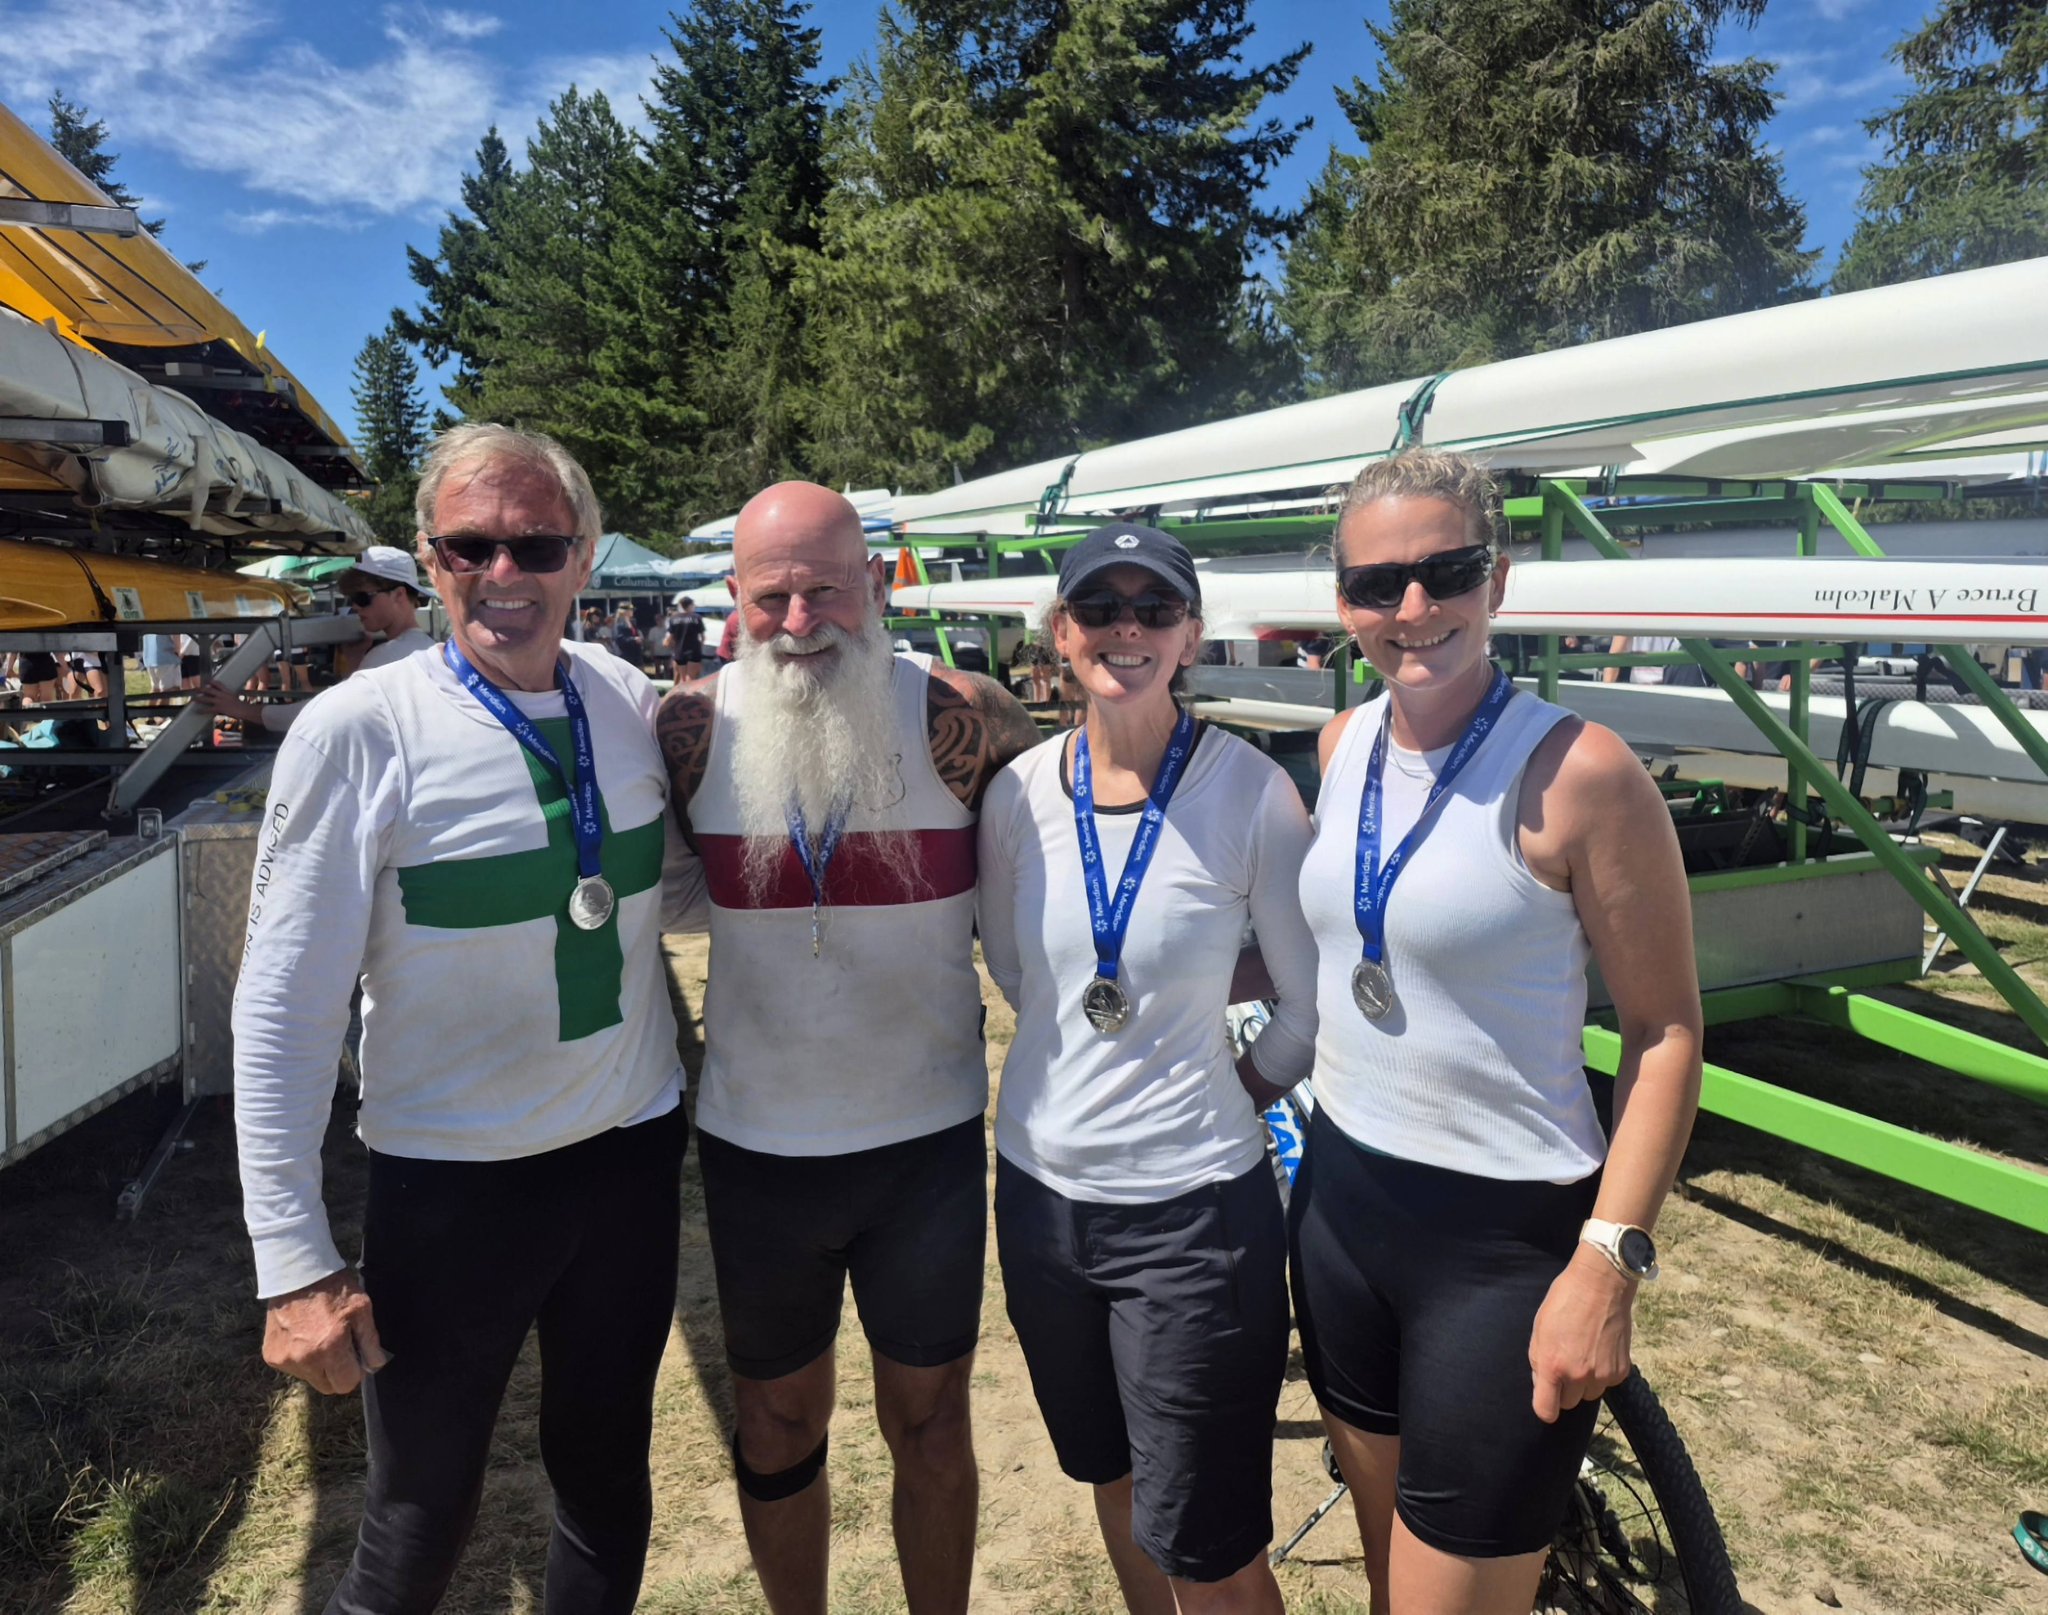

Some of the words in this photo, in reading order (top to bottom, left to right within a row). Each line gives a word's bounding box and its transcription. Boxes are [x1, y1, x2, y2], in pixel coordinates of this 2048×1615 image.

[614, 576, 660, 588] Columba
[1814, 589, 1917, 611] Malcolm
[1928, 589, 1947, 612] A
[1957, 588, 2038, 612] Bruce
[478, 683, 507, 714] Meridian
[526, 733, 558, 764] Meridian
[579, 718, 588, 752] Meridian
[1450, 733, 1479, 770] Meridian
[1158, 760, 1177, 793] Meridian
[585, 781, 593, 819] Meridian
[1365, 779, 1378, 819] Meridian
[1081, 810, 1093, 848] Meridian
[1133, 823, 1154, 862] Meridian
[255, 802, 290, 898] ADVISED
[1360, 850, 1372, 894] Meridian
[249, 902, 262, 926] IS
[1092, 877, 1105, 917] Meridian
